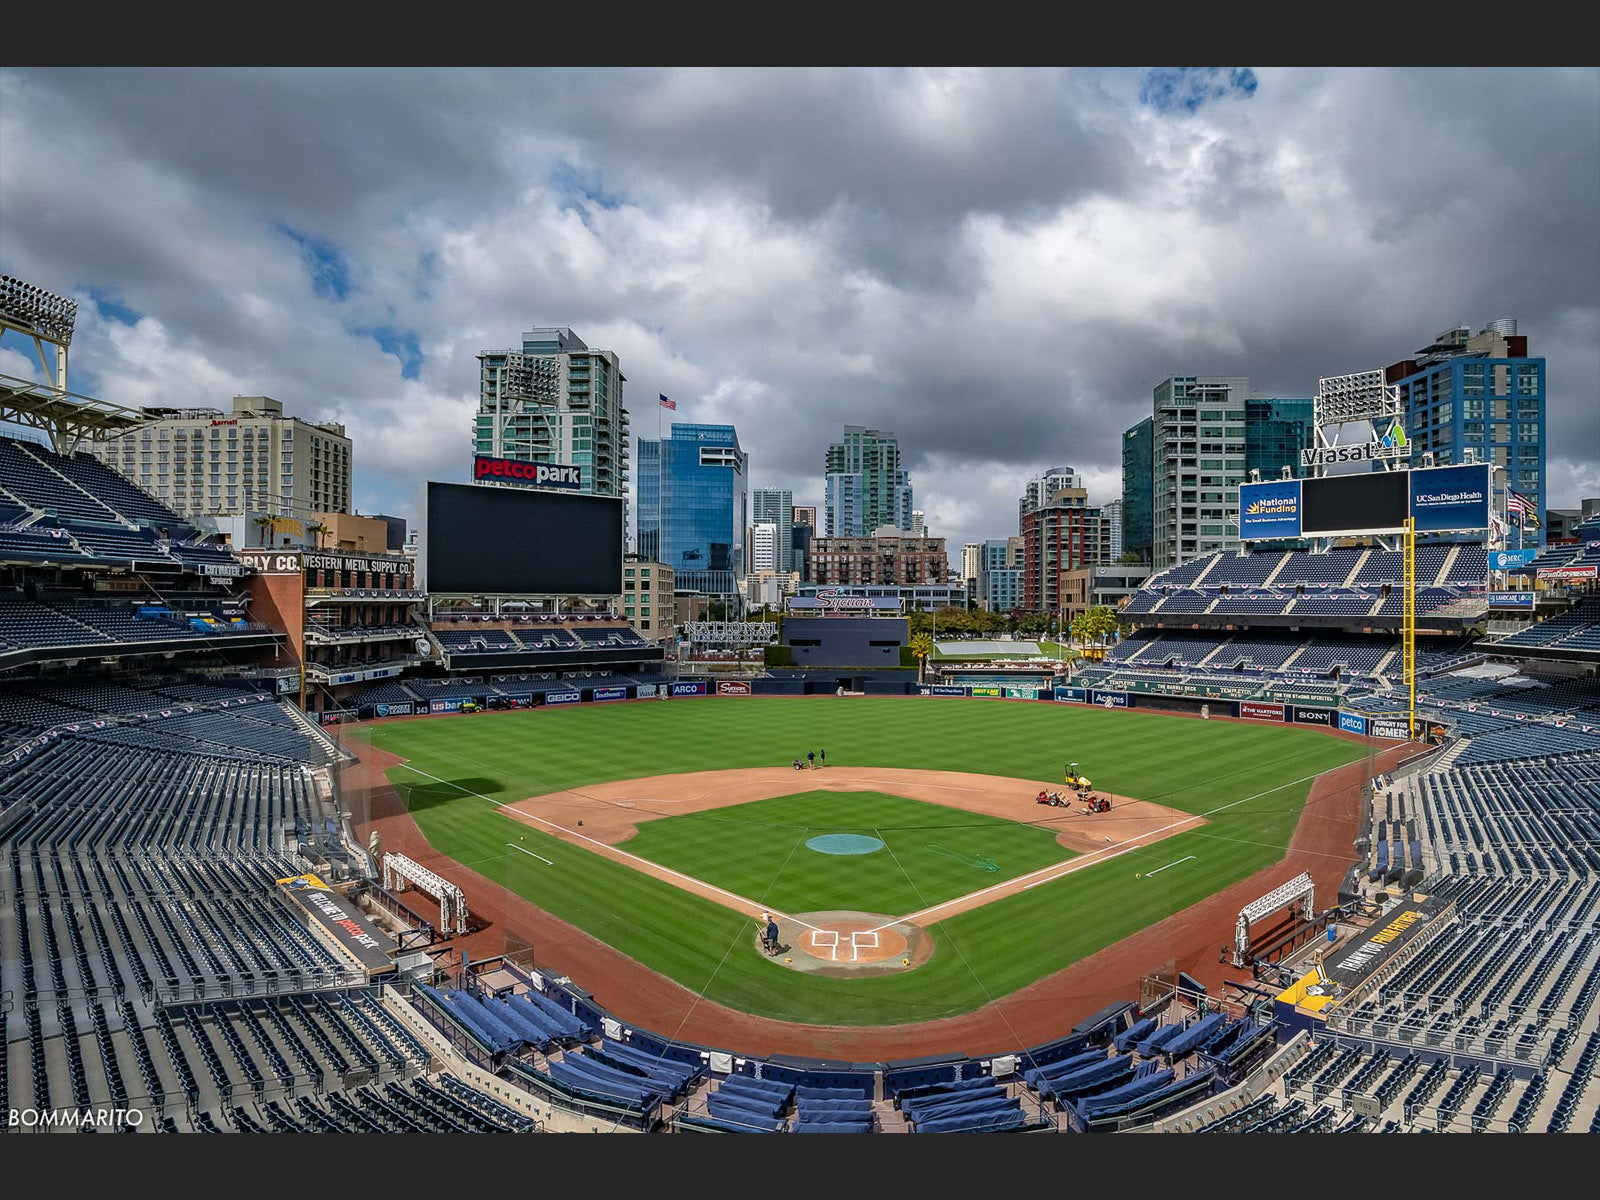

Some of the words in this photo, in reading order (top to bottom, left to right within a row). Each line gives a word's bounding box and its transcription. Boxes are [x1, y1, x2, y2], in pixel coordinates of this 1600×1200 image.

[1303, 442, 1375, 465] Viasat
[1259, 496, 1297, 507] National
[1427, 494, 1440, 502] San
[1440, 493, 1460, 502] Diego
[1460, 492, 1482, 500] Health
[1259, 505, 1297, 513] Funding
[276, 555, 301, 571] CO.
[301, 554, 343, 569] WESTERN
[345, 558, 372, 572] METAL
[371, 560, 399, 573] SUPPLY
[399, 562, 411, 574] CO.
[815, 588, 875, 612] Sycuan
[674, 684, 698, 694] ARCO
[547, 693, 580, 703] GEICO
[1298, 711, 1329, 720] SONY
[1341, 717, 1363, 729] petco
